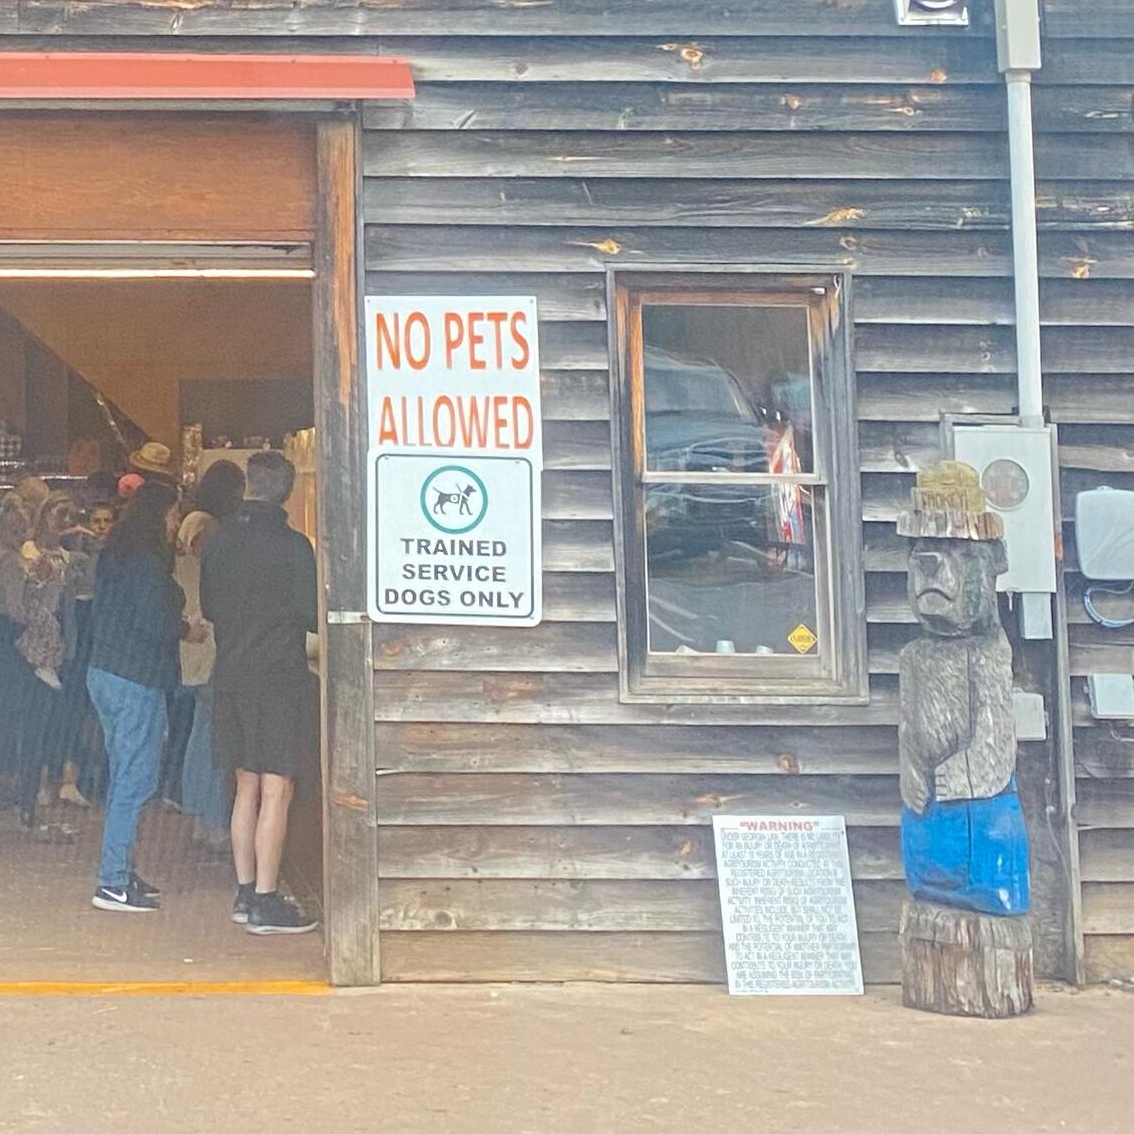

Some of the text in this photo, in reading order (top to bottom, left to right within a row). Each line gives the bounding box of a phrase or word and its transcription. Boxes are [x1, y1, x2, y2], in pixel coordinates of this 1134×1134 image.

[375, 311, 530, 370] NO PETS
[378, 395, 535, 450] ALLOWED
[401, 538, 506, 556] TRAINED
[402, 564, 506, 582] SERVICE
[384, 588, 523, 609] DOGS ONLY
